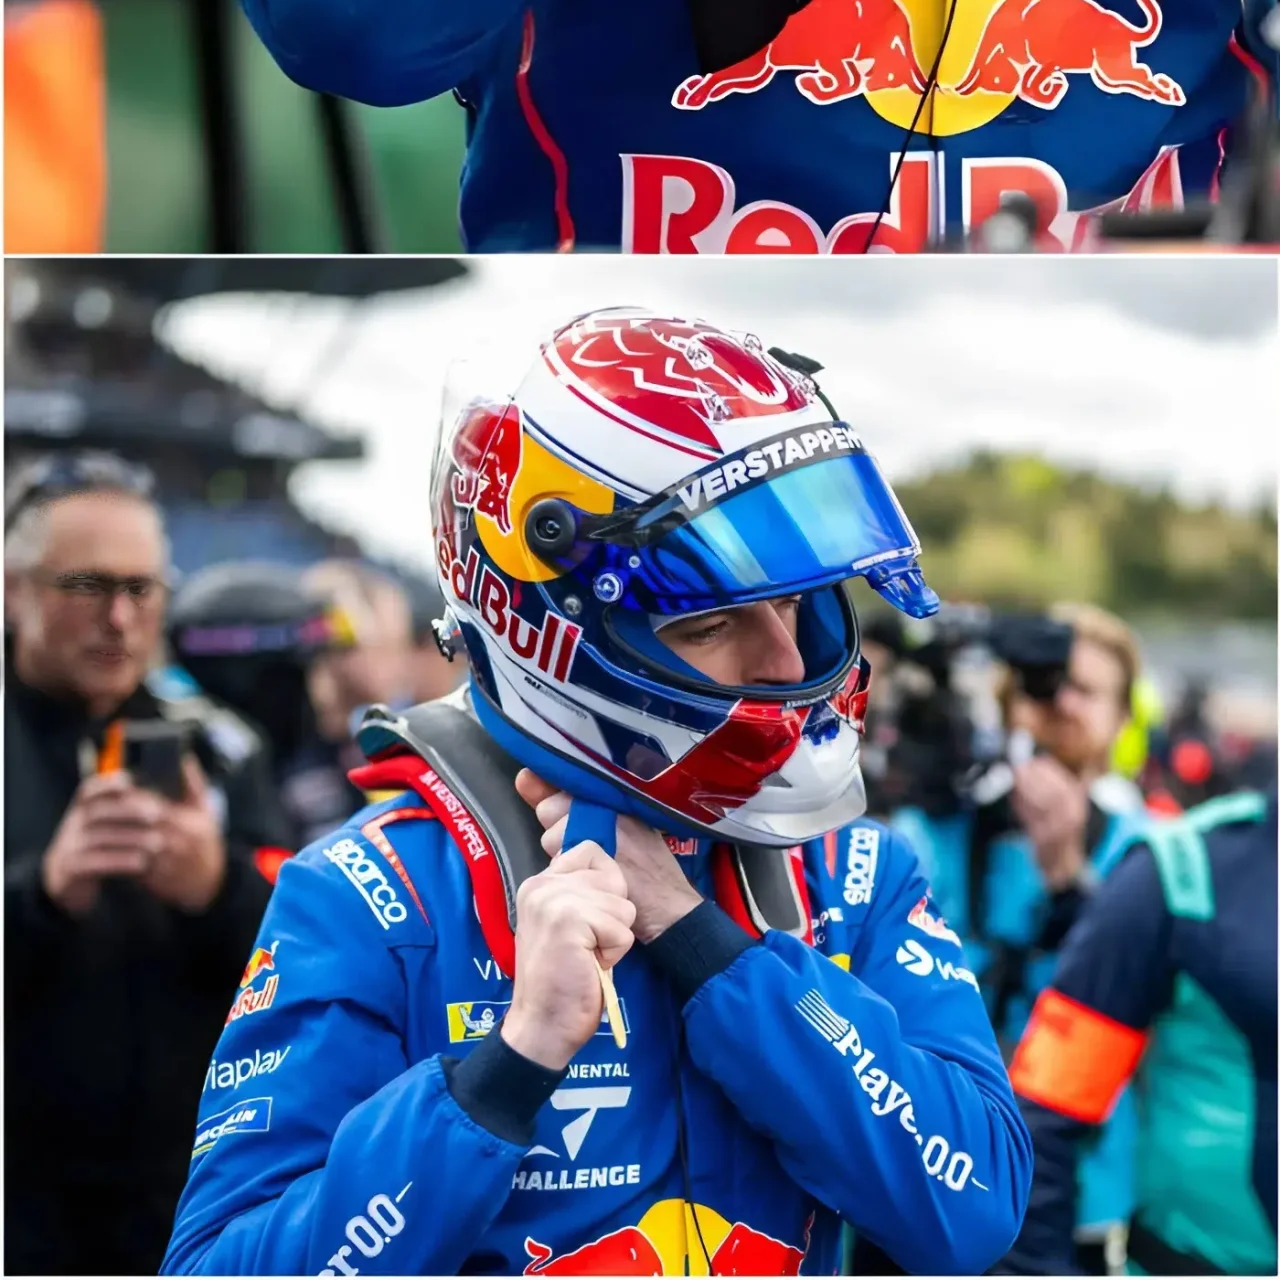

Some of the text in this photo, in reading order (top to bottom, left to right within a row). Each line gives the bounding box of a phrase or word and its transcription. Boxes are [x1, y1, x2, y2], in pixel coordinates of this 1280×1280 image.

[676, 425, 863, 512] VERSTAPPEN
[478, 563, 584, 684] Bull
[323, 837, 408, 926] sparco
[832, 1027, 923, 1146] Playe
